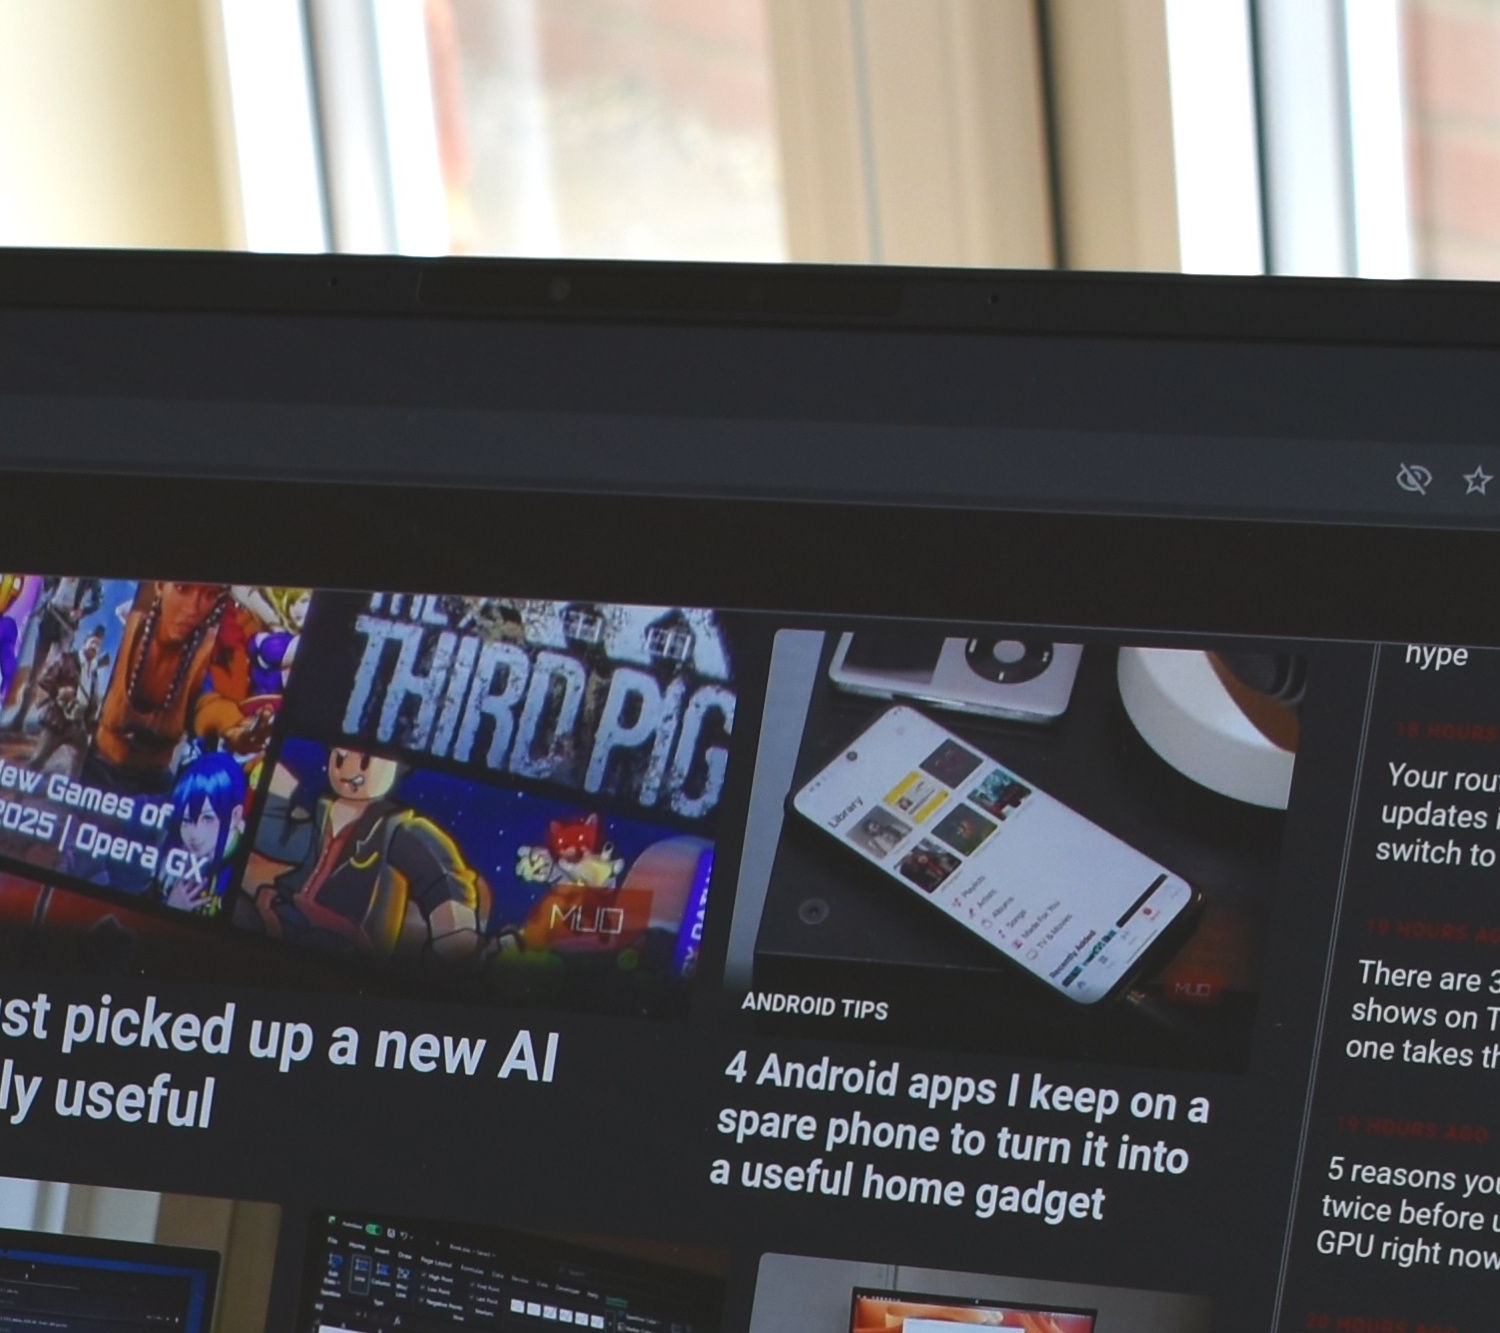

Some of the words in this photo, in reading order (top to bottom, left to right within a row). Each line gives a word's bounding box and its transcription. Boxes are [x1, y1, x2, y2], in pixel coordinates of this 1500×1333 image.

[342, 614, 588, 779] THIRD
[584, 665, 738, 819] PIG
[47, 773, 135, 819] Games
[139, 802, 175, 830] of
[1388, 761, 1449, 789] Your
[1381, 800, 1488, 830] updates
[75, 822, 159, 871] Opera
[164, 846, 209, 884] GX
[1375, 838, 1462, 865] switch
[1469, 843, 1496, 867] to
[550, 903, 624, 935] MUO
[741, 991, 836, 1017] ANDROID
[841, 998, 889, 1021] TIPS
[61, 993, 236, 1055] picked
[249, 1019, 314, 1073] up
[328, 1026, 359, 1066] a
[374, 1030, 487, 1076] new
[497, 1029, 560, 1083] AI
[54, 1072, 216, 1129] useful
[724, 1050, 747, 1084] 4
[755, 1052, 900, 1097] Android
[908, 1073, 997, 1112] apps
[1007, 1072, 1020, 1107] I
[1029, 1072, 1120, 1124] keep
[1130, 1091, 1177, 1121] on
[1187, 1096, 1210, 1124] a
[717, 1108, 817, 1144] spare
[825, 1110, 940, 1152] phone
[950, 1122, 986, 1156] to
[996, 1126, 1071, 1165] turn
[1081, 1130, 1109, 1168] it
[1117, 1134, 1189, 1175] into
[709, 1159, 731, 1185] a
[741, 1158, 854, 1197] useful
[862, 1163, 965, 1207] home
[975, 1179, 1106, 1225] gadget
